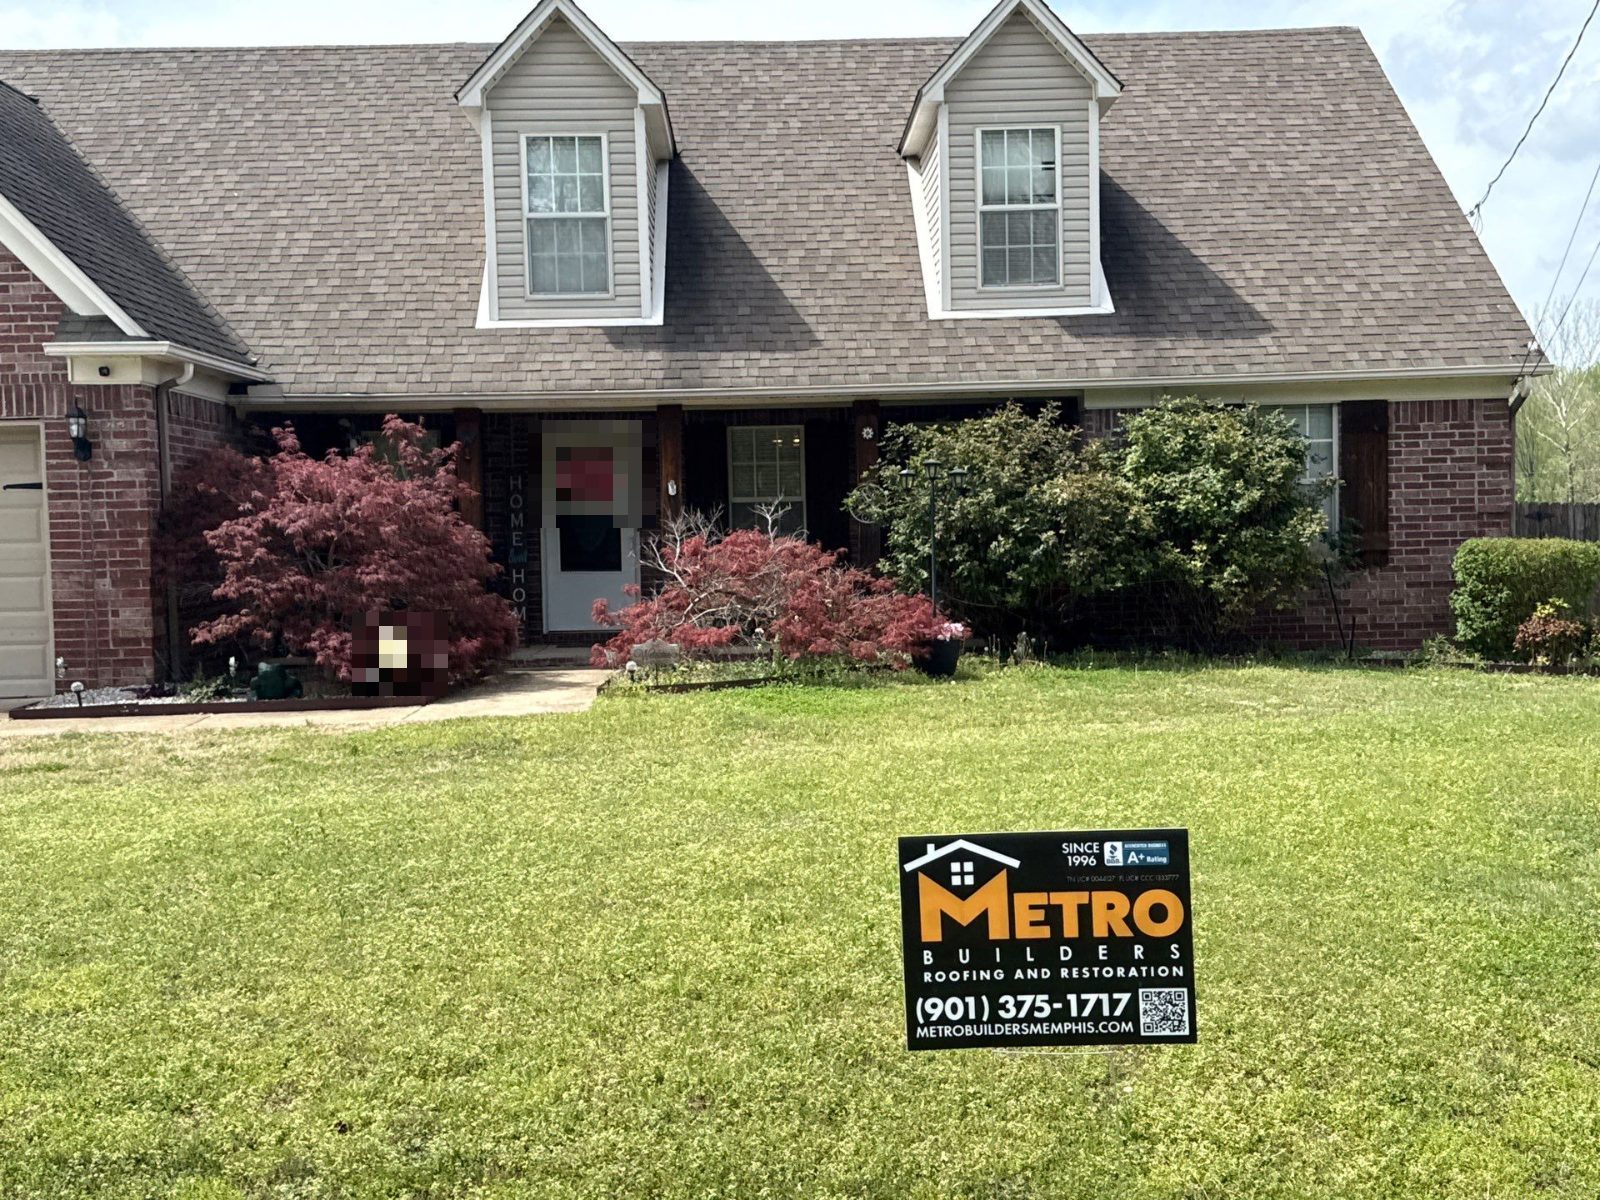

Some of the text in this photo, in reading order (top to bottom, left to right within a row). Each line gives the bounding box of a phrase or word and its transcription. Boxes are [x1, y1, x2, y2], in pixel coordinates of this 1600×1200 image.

[509, 475, 524, 546] HOME
[1061, 842, 1100, 855] SINCE
[1127, 851, 1168, 864] A+ Rating
[1067, 855, 1097, 867] 1996
[918, 868, 1185, 942] METRO
[923, 944, 1181, 965] BUILDERS
[923, 965, 1184, 983] ROOFING AND RESTORATION
[916, 992, 1132, 1024] (901) 375-1717
[916, 1021, 1134, 1038] METROBUILDERSMEMPHIS.COM
